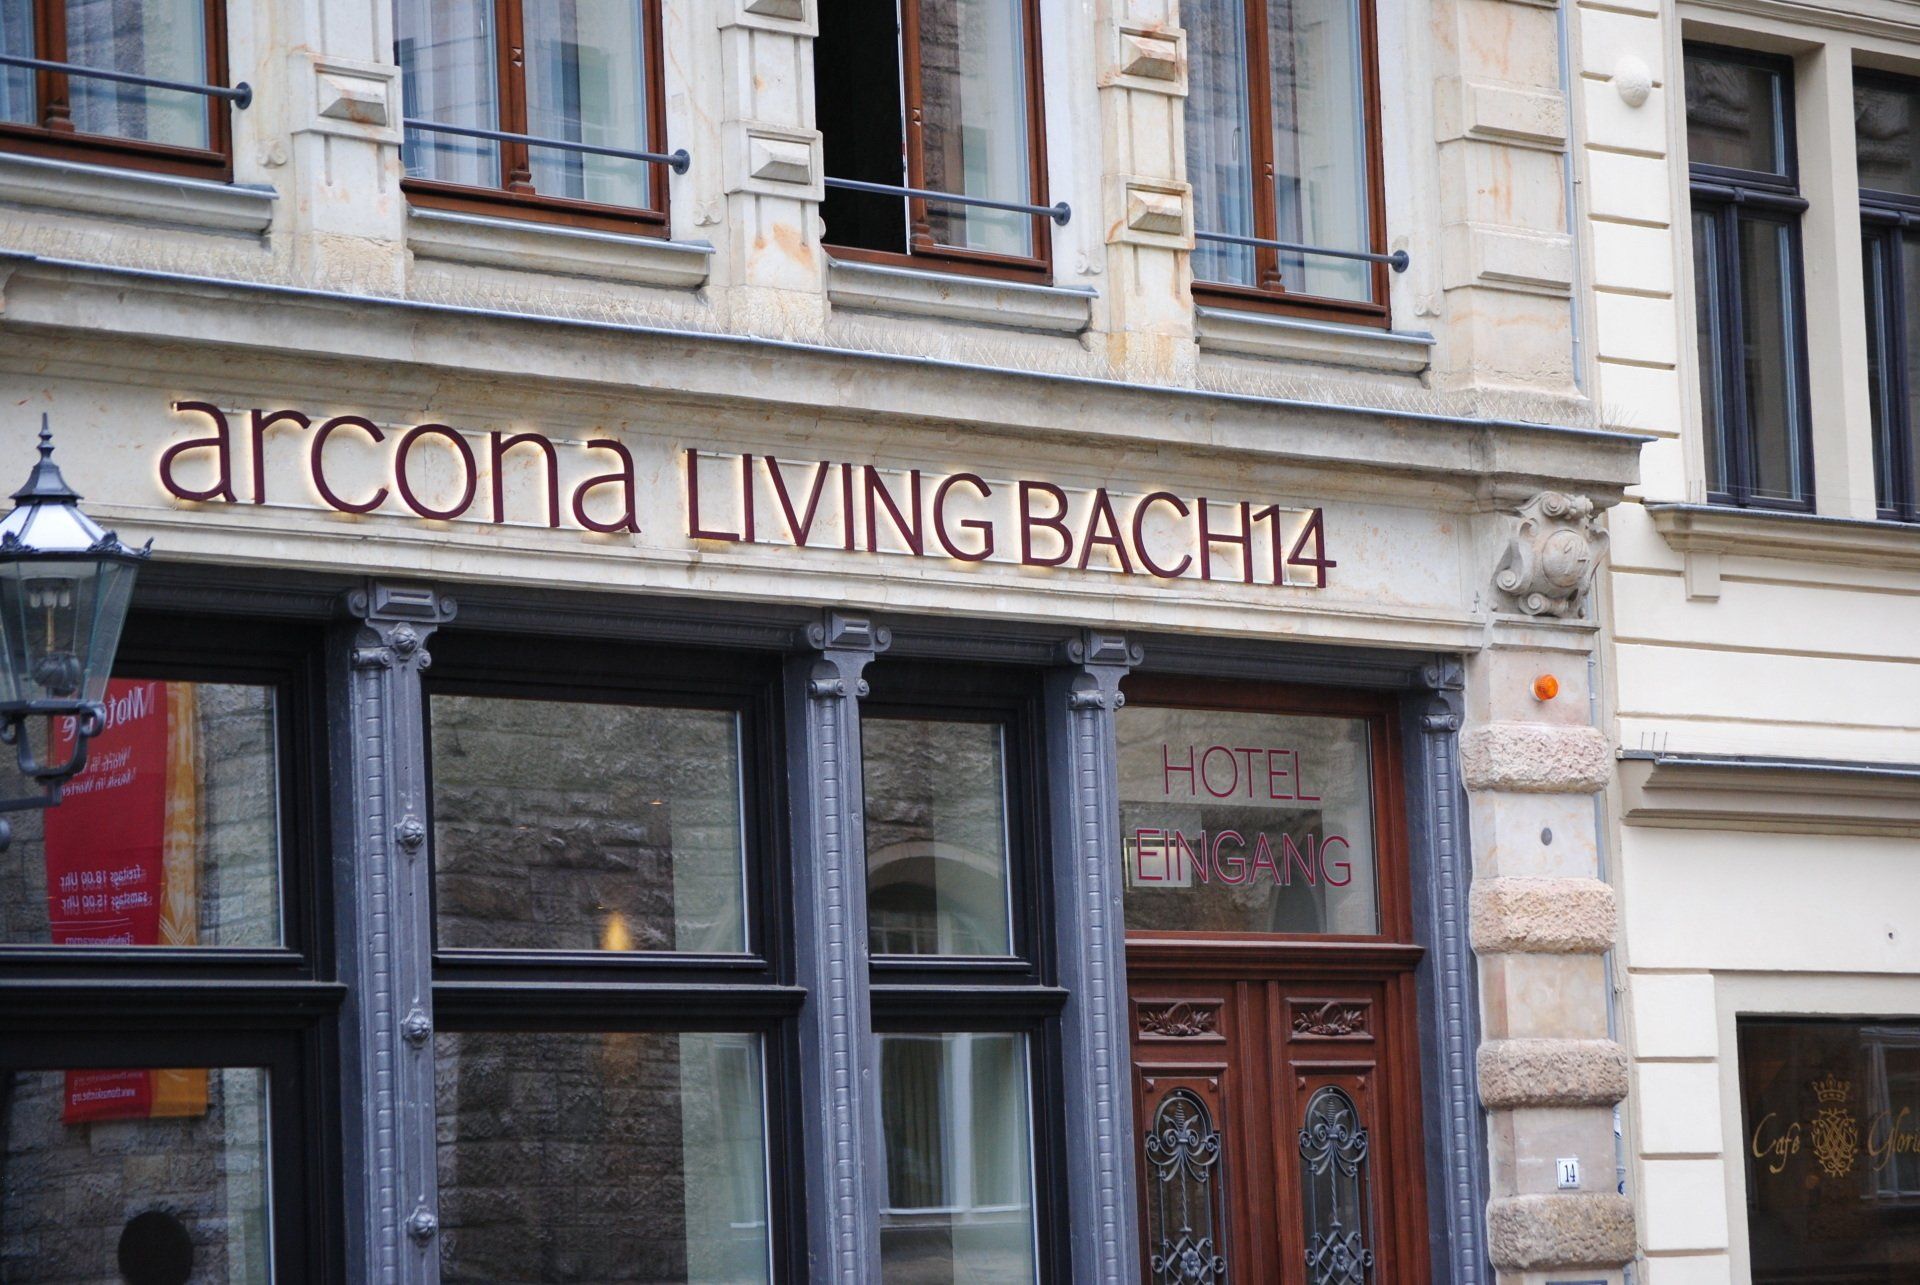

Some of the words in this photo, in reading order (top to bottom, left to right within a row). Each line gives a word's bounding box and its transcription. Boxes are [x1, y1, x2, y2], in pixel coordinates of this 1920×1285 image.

[159, 401, 641, 533] arcona
[687, 448, 993, 561] LIVING
[1164, 744, 1321, 801] HOTEL
[1136, 829, 1352, 887] EINGANG
[1564, 1163, 1576, 1183] 14
